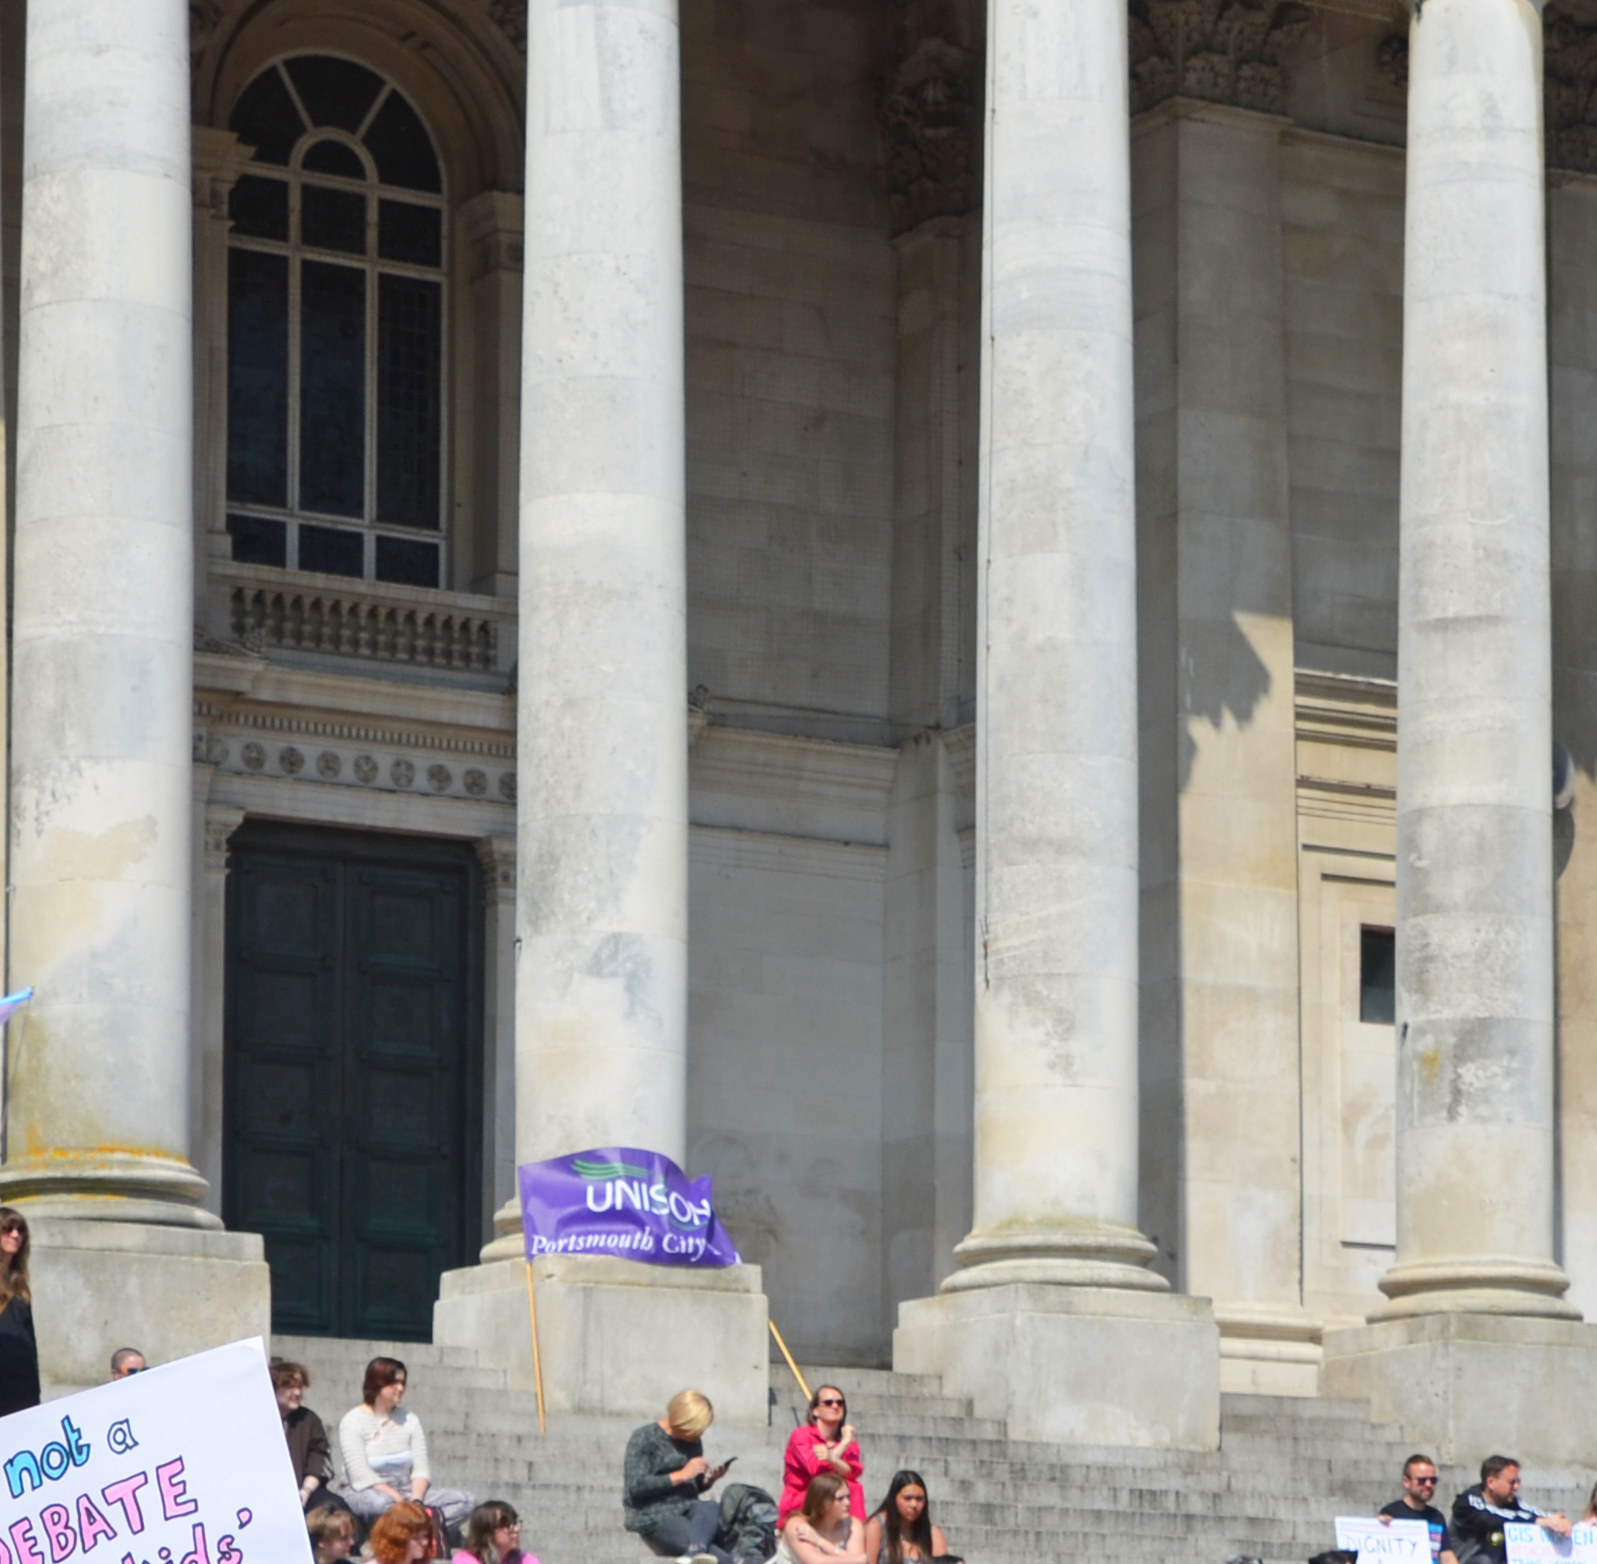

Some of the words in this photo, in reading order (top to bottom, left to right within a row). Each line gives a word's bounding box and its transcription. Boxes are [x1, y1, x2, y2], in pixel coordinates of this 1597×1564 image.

[531, 1226, 654, 1254] Portsmouth
[662, 1233, 704, 1262] City
[3, 1414, 91, 1499] not
[106, 1418, 139, 1454] a
[1346, 1535, 1418, 1556] DIGNITY
